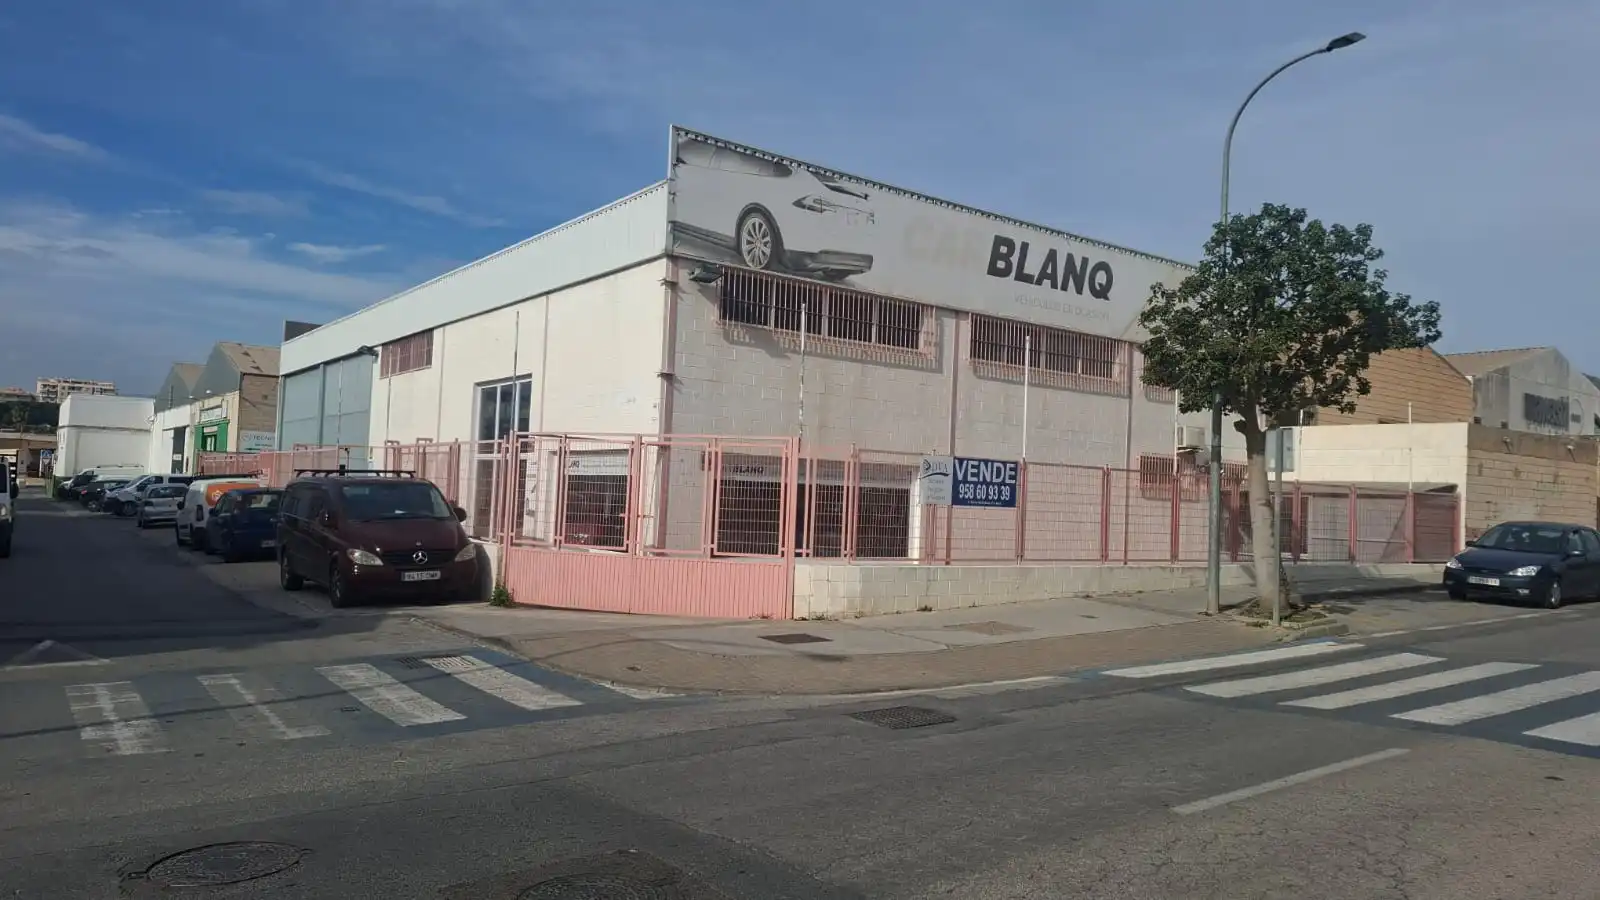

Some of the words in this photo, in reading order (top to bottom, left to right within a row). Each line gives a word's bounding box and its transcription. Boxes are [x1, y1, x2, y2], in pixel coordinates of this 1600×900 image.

[986, 234, 1115, 301] BLANQ
[954, 459, 1016, 484] VENDE
[959, 483, 974, 499] 958
[976, 485, 987, 499] 60
[988, 485, 999, 500] 93
[1000, 486, 1010, 501] 39
